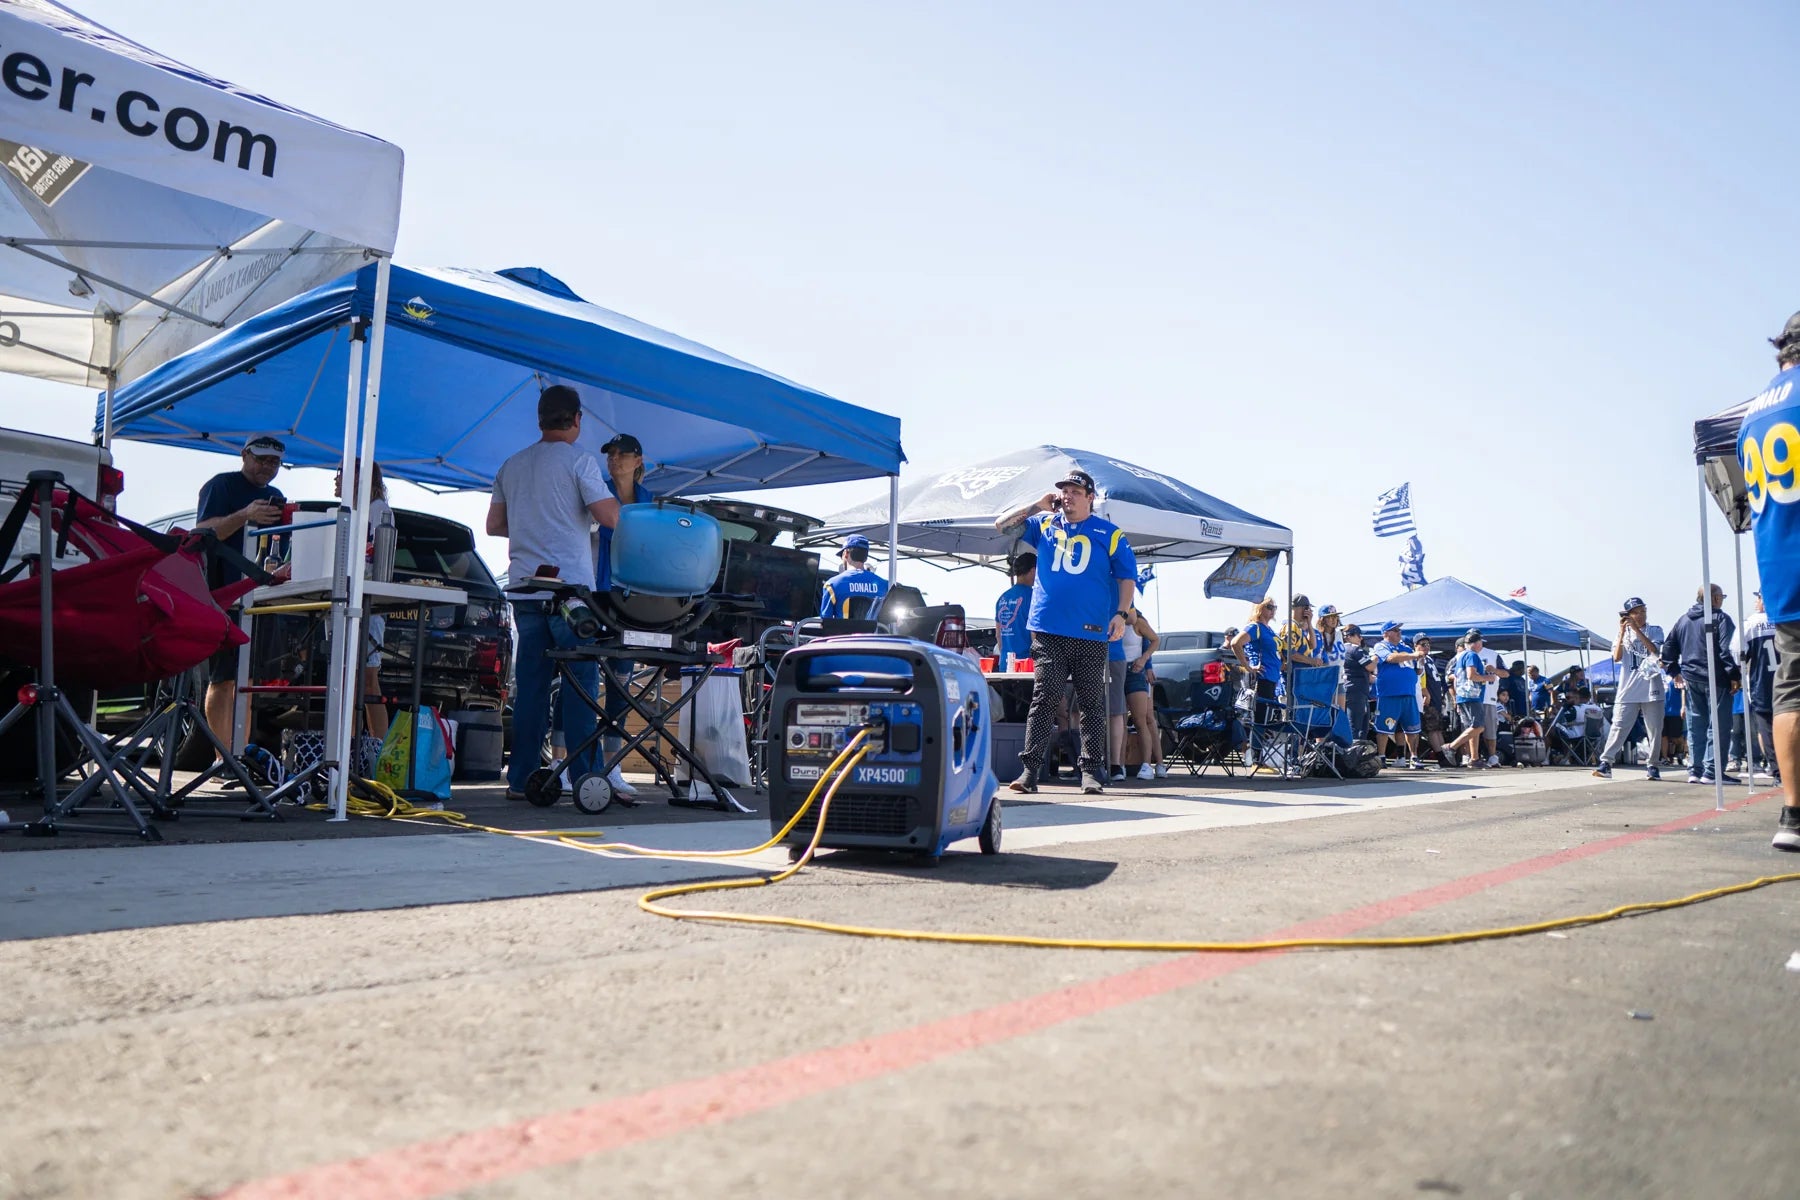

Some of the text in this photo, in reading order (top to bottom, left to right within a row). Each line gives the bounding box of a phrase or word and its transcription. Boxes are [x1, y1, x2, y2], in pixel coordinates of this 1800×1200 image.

[1743, 422, 1800, 514] 99
[1200, 518, 1223, 538] Rams
[1051, 530, 1092, 575] 10
[849, 582, 878, 593] DONALD
[859, 767, 905, 782] XP4500
